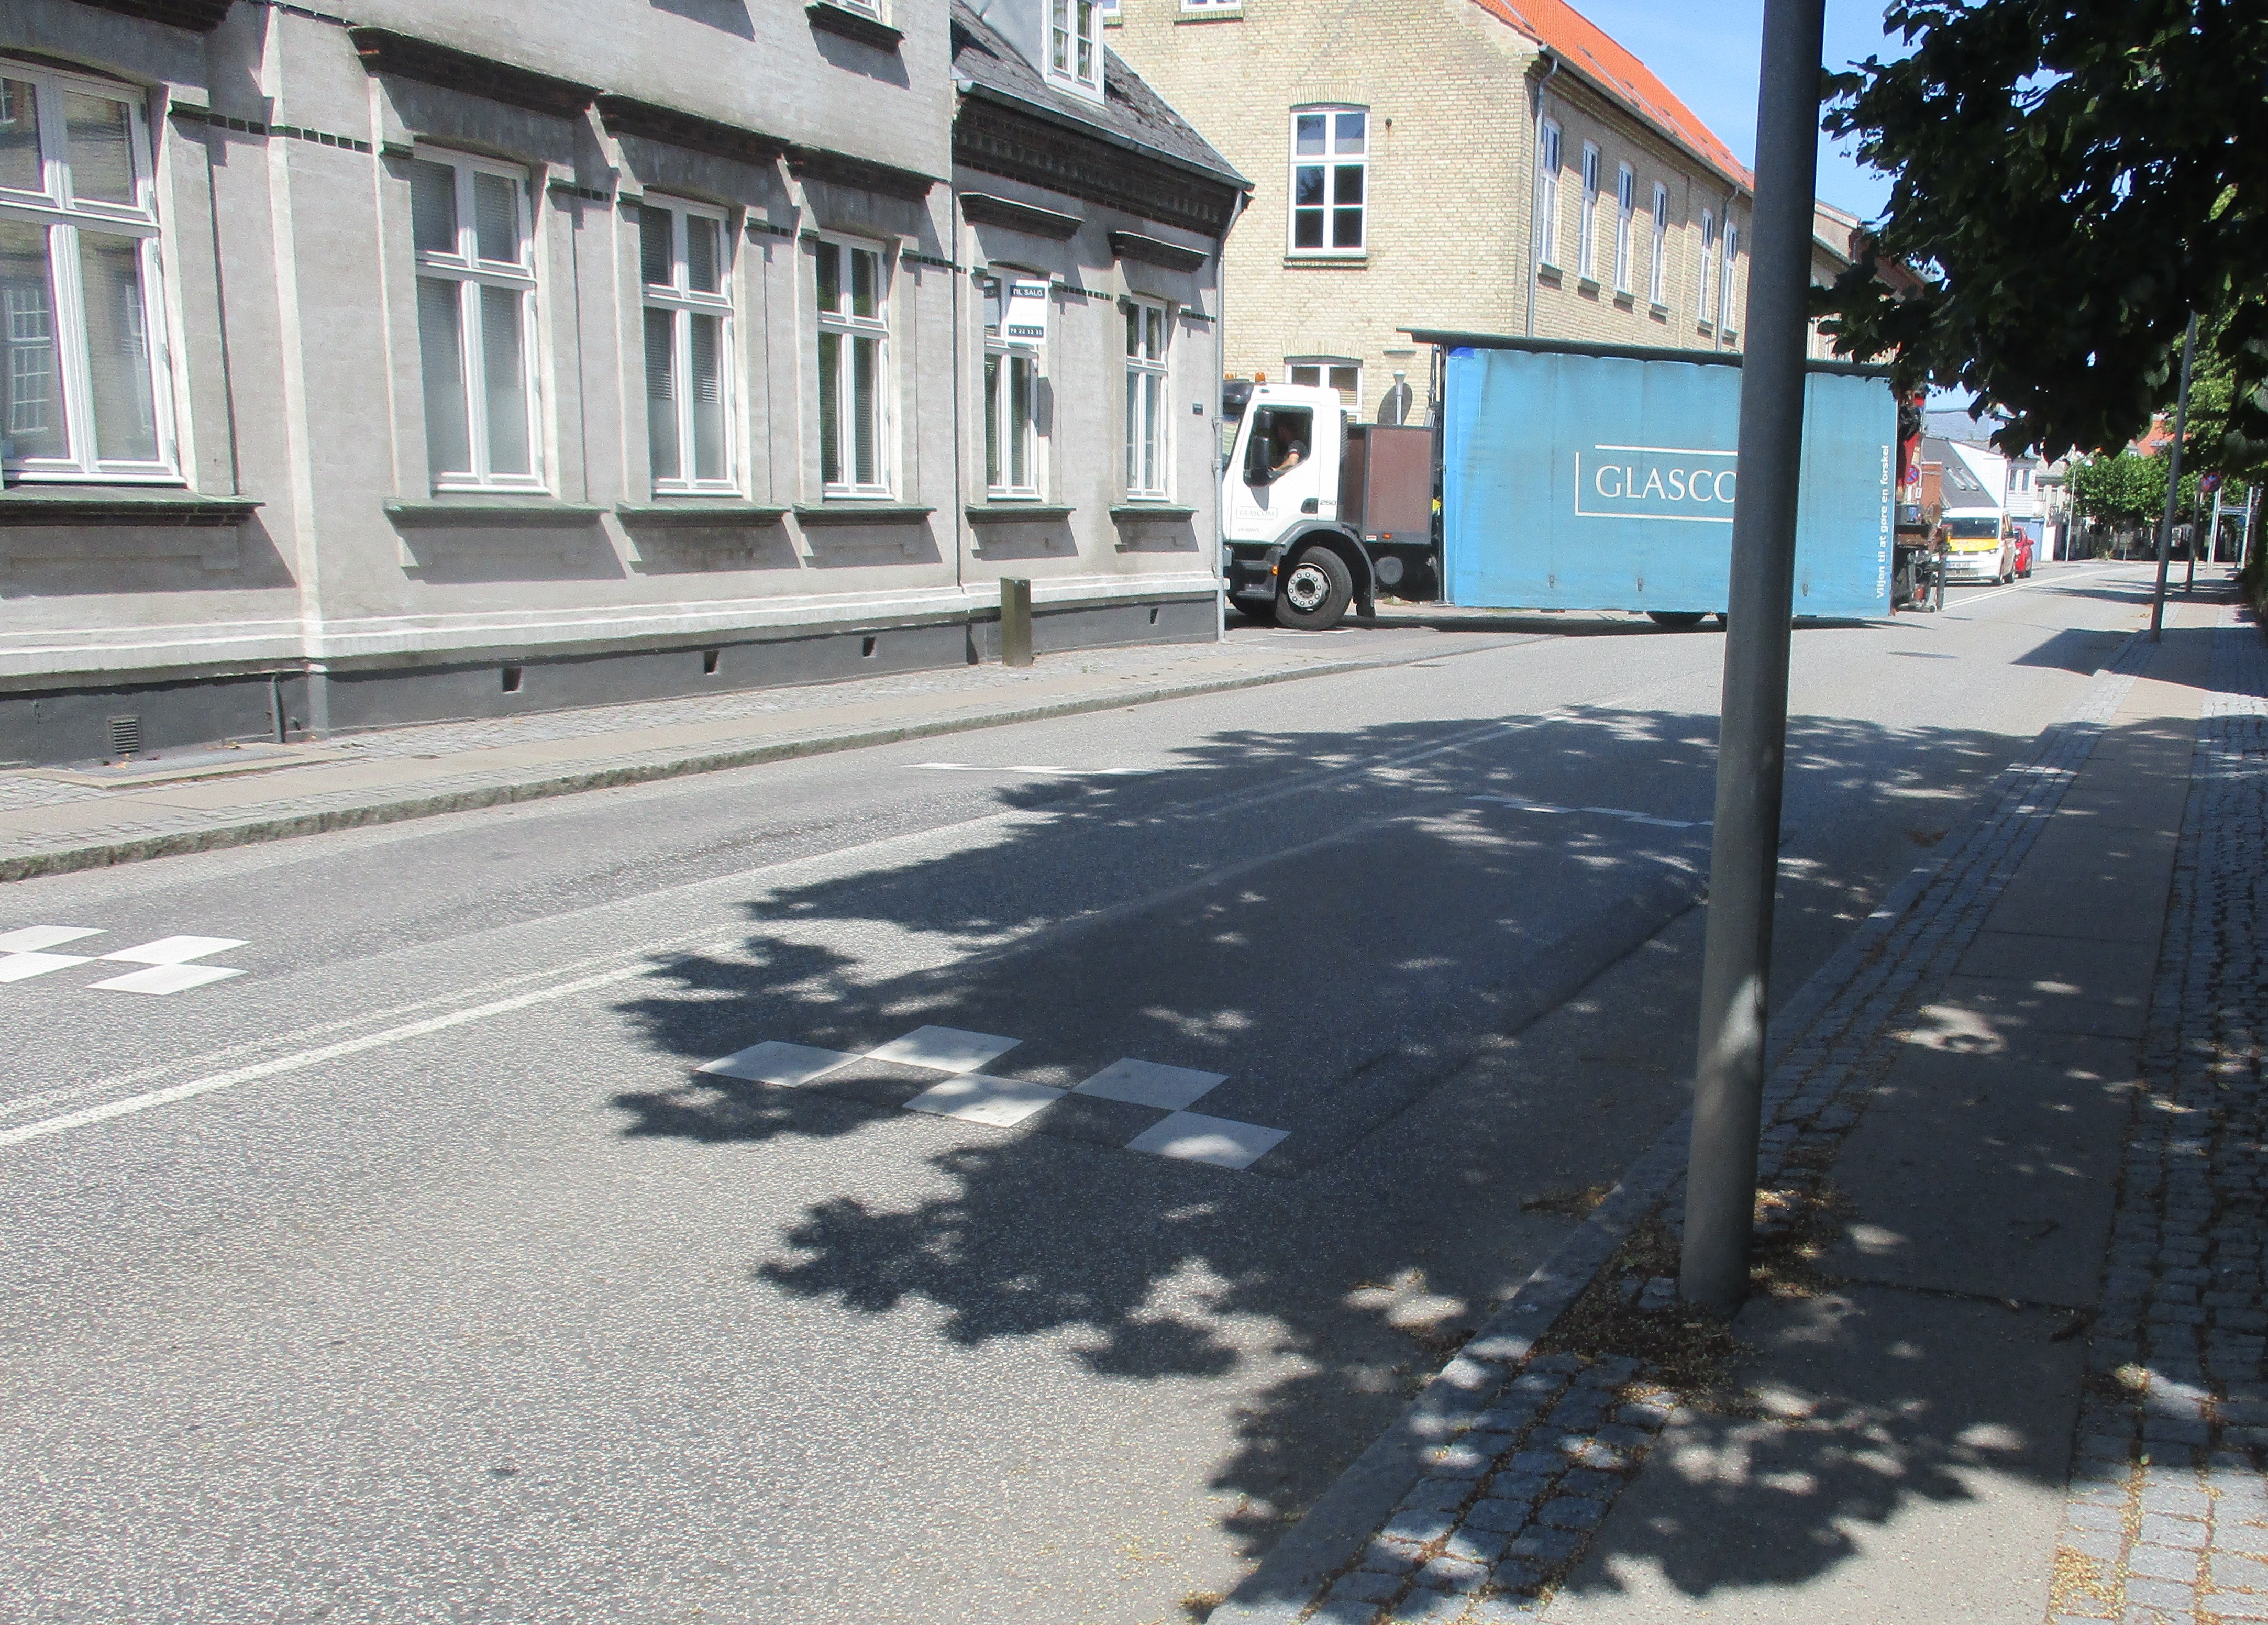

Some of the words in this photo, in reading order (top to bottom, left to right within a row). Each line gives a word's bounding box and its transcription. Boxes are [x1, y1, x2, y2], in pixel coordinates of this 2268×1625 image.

[1880, 445, 1889, 485] forskel
[1595, 465, 1737, 503] GLASCO
[1881, 489, 1888, 503] en
[1879, 536, 1886, 548] at
[1877, 551, 1886, 562] til
[1876, 566, 1886, 599] Viljen
